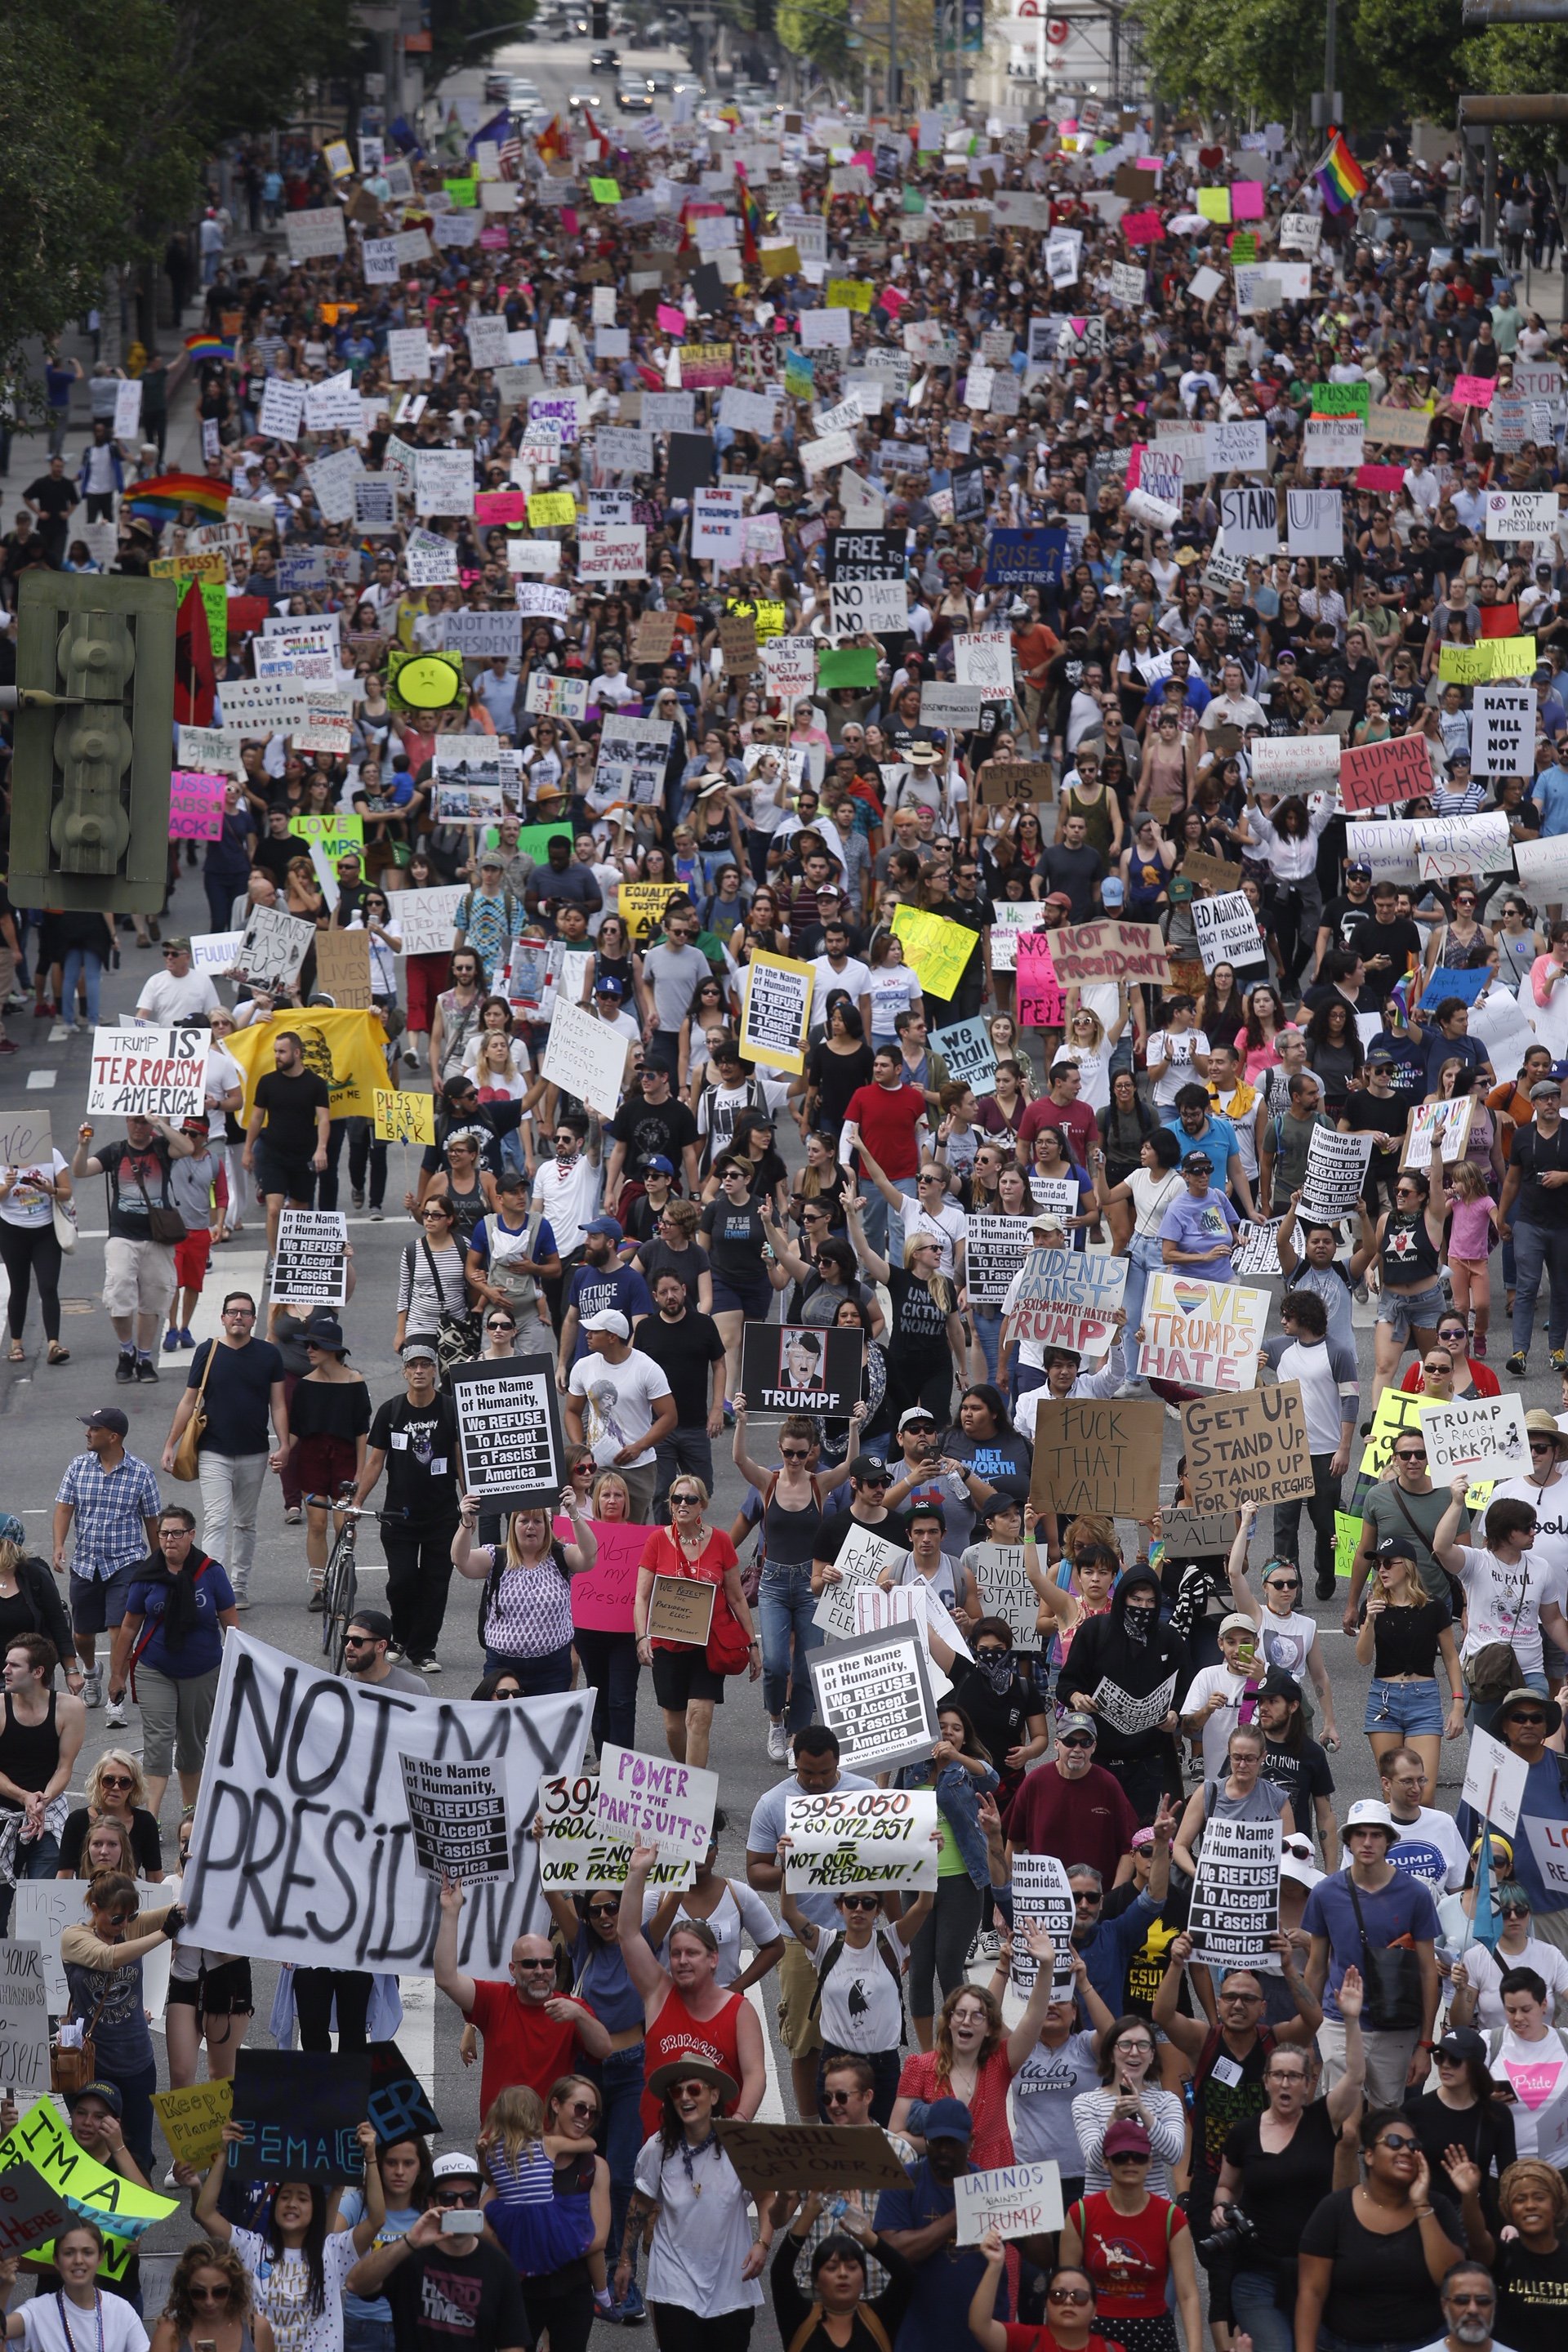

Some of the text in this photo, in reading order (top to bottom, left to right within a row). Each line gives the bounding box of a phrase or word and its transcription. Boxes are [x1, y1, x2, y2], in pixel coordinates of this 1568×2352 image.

[1319, 385, 1368, 402] PUSSIES
[1216, 423, 1257, 437] JEWS
[1218, 438, 1259, 451] AGAINST
[1211, 449, 1255, 462] TRUMP
[706, 490, 732, 500] LOVE
[1512, 496, 1543, 506] NOT
[697, 508, 740, 519] TRUMPS
[1225, 492, 1276, 529] STAND
[1290, 492, 1342, 530] UP!
[1514, 510, 1533, 518] MY
[198, 522, 245, 545] UNITY
[702, 525, 731, 536] HATE
[1498, 519, 1556, 532] PRESIDENT
[834, 537, 903, 564] FREE TO
[993, 545, 1040, 568] RISE
[180, 555, 221, 571] PUSSY
[835, 565, 898, 582] RESIST
[998, 571, 1055, 583] TOGETHER
[833, 585, 902, 607] NO HATE
[446, 613, 518, 629] NOT MY
[836, 613, 903, 632] NO FEAR
[283, 635, 328, 657] SHALL
[445, 632, 523, 654] PRESIDENT
[960, 632, 1005, 647] PINCHE
[778, 651, 797, 660] THIS
[1441, 650, 1469, 662] LOVE
[767, 662, 800, 675] NASTY
[243, 684, 283, 694] LOVE
[223, 696, 305, 710] REVOLUTION
[1484, 698, 1529, 710] HATE
[229, 716, 301, 730] TELEVISED
[1488, 719, 1521, 732] WILL
[184, 731, 225, 744] BE THE
[1488, 739, 1519, 751] NOT
[189, 744, 234, 762] CHANGE
[1351, 740, 1425, 777] HUMAN
[985, 765, 1047, 779] REMEMBER
[1487, 759, 1517, 770] WIN
[1004, 780, 1032, 798] US
[1350, 760, 1435, 809] RIGHTS
[296, 817, 348, 835] LOVE
[1415, 816, 1473, 834] TRUMP
[1352, 825, 1414, 849] NOT MY
[1423, 853, 1470, 879] ASS
[318, 934, 367, 957] BLACK
[405, 933, 449, 952] HATE
[1059, 922, 1151, 955] NOT MY
[320, 962, 366, 982] LIVES
[109, 1029, 202, 1059] TRUMP IS
[941, 1027, 972, 1050] we
[942, 1038, 990, 1071] shall
[94, 1057, 204, 1088] TERRORISM
[114, 1087, 198, 1116] AMERICA
[376, 1091, 424, 1113] PUSSY
[377, 1108, 425, 1126] GRABS
[1321, 1132, 1361, 1146] nombre de
[1318, 1141, 1362, 1157] humanidad,
[1312, 1154, 1360, 1169] nosotros nos
[1308, 1165, 1360, 1180] NEGAMOS
[1310, 1178, 1339, 1191] aceptar
[1303, 1186, 1356, 1203] Estados Unidos
[1311, 1204, 1343, 1214] fascista
[579, 1283, 617, 1301] LETTUCE
[579, 1297, 611, 1313] TURNIP
[1009, 1310, 1107, 1351] TRUMP
[1148, 1313, 1258, 1358] TRUMPS
[1140, 1345, 1243, 1389] HATE
[460, 1379, 533, 1398] In the Name
[462, 1393, 538, 1412] of Humanity,
[761, 1390, 840, 1410] TRUMPF
[466, 1411, 542, 1432] We REFUSE
[1060, 1403, 1129, 1441] FUCK
[1186, 1389, 1298, 1436] GET UP
[1426, 1405, 1502, 1432] TRUMP
[475, 1430, 537, 1449] To Accept
[1192, 1423, 1305, 1467] STAND UP
[480, 1446, 537, 1465] a Fascist
[975, 1449, 1002, 1463] NET
[1436, 1435, 1497, 1465] OKKK?!
[1048, 1444, 1128, 1478] THAT
[485, 1466, 536, 1482] America
[1195, 1454, 1304, 1491] STAND UP
[479, 1481, 546, 1494] www.revcom.us
[1049, 1477, 1135, 1515] WALL!
[1195, 1475, 1315, 1517] FOR YOUR RIGHTS
[1183, 1525, 1234, 1546] ALL
[866, 1537, 889, 1559] WE
[659, 1582, 672, 1592] WE
[984, 1587, 1040, 1606] STATES
[670, 1611, 691, 1619] ELECT
[220, 1653, 416, 1815] NOT
[617, 1753, 689, 1797] POWER
[630, 1789, 668, 1808] TO THE
[791, 1793, 911, 1819] 395,050
[597, 1793, 706, 1846] PANTSUITS
[1206, 1824, 1274, 1841] In the Name
[786, 1852, 858, 1869] NOT OUR
[1203, 1841, 1276, 1861] of Humanity,
[1385, 1854, 1433, 1866] DUMP
[543, 1861, 579, 1882] OUR
[1200, 1864, 1277, 1885] We REFUSE
[18, 1884, 66, 1913] This
[1202, 1888, 1270, 1909] To Accept
[1202, 1912, 1267, 1931] a Fascist
[1205, 1935, 1263, 1953] America
[2, 1947, 42, 1977] YOUR
[1197, 1953, 1269, 1967] www.revcom.us
[659, 2032, 724, 2065] SRIRACHA
[1020, 2081, 1071, 2096] BRUINS
[1513, 2074, 1553, 2091] Pride
[160, 2094, 216, 2119] Keep
[172, 2114, 226, 2140] Planet
[228, 2119, 364, 2174] FEMALE
[20, 2109, 120, 2212] I'M A
[441, 2161, 472, 2175] RVCA
[964, 2167, 1044, 2195] LATINOS
[977, 2206, 1043, 2235] TRUMP
[422, 2273, 481, 2309] HARD
[422, 2298, 479, 2329] TIMES
